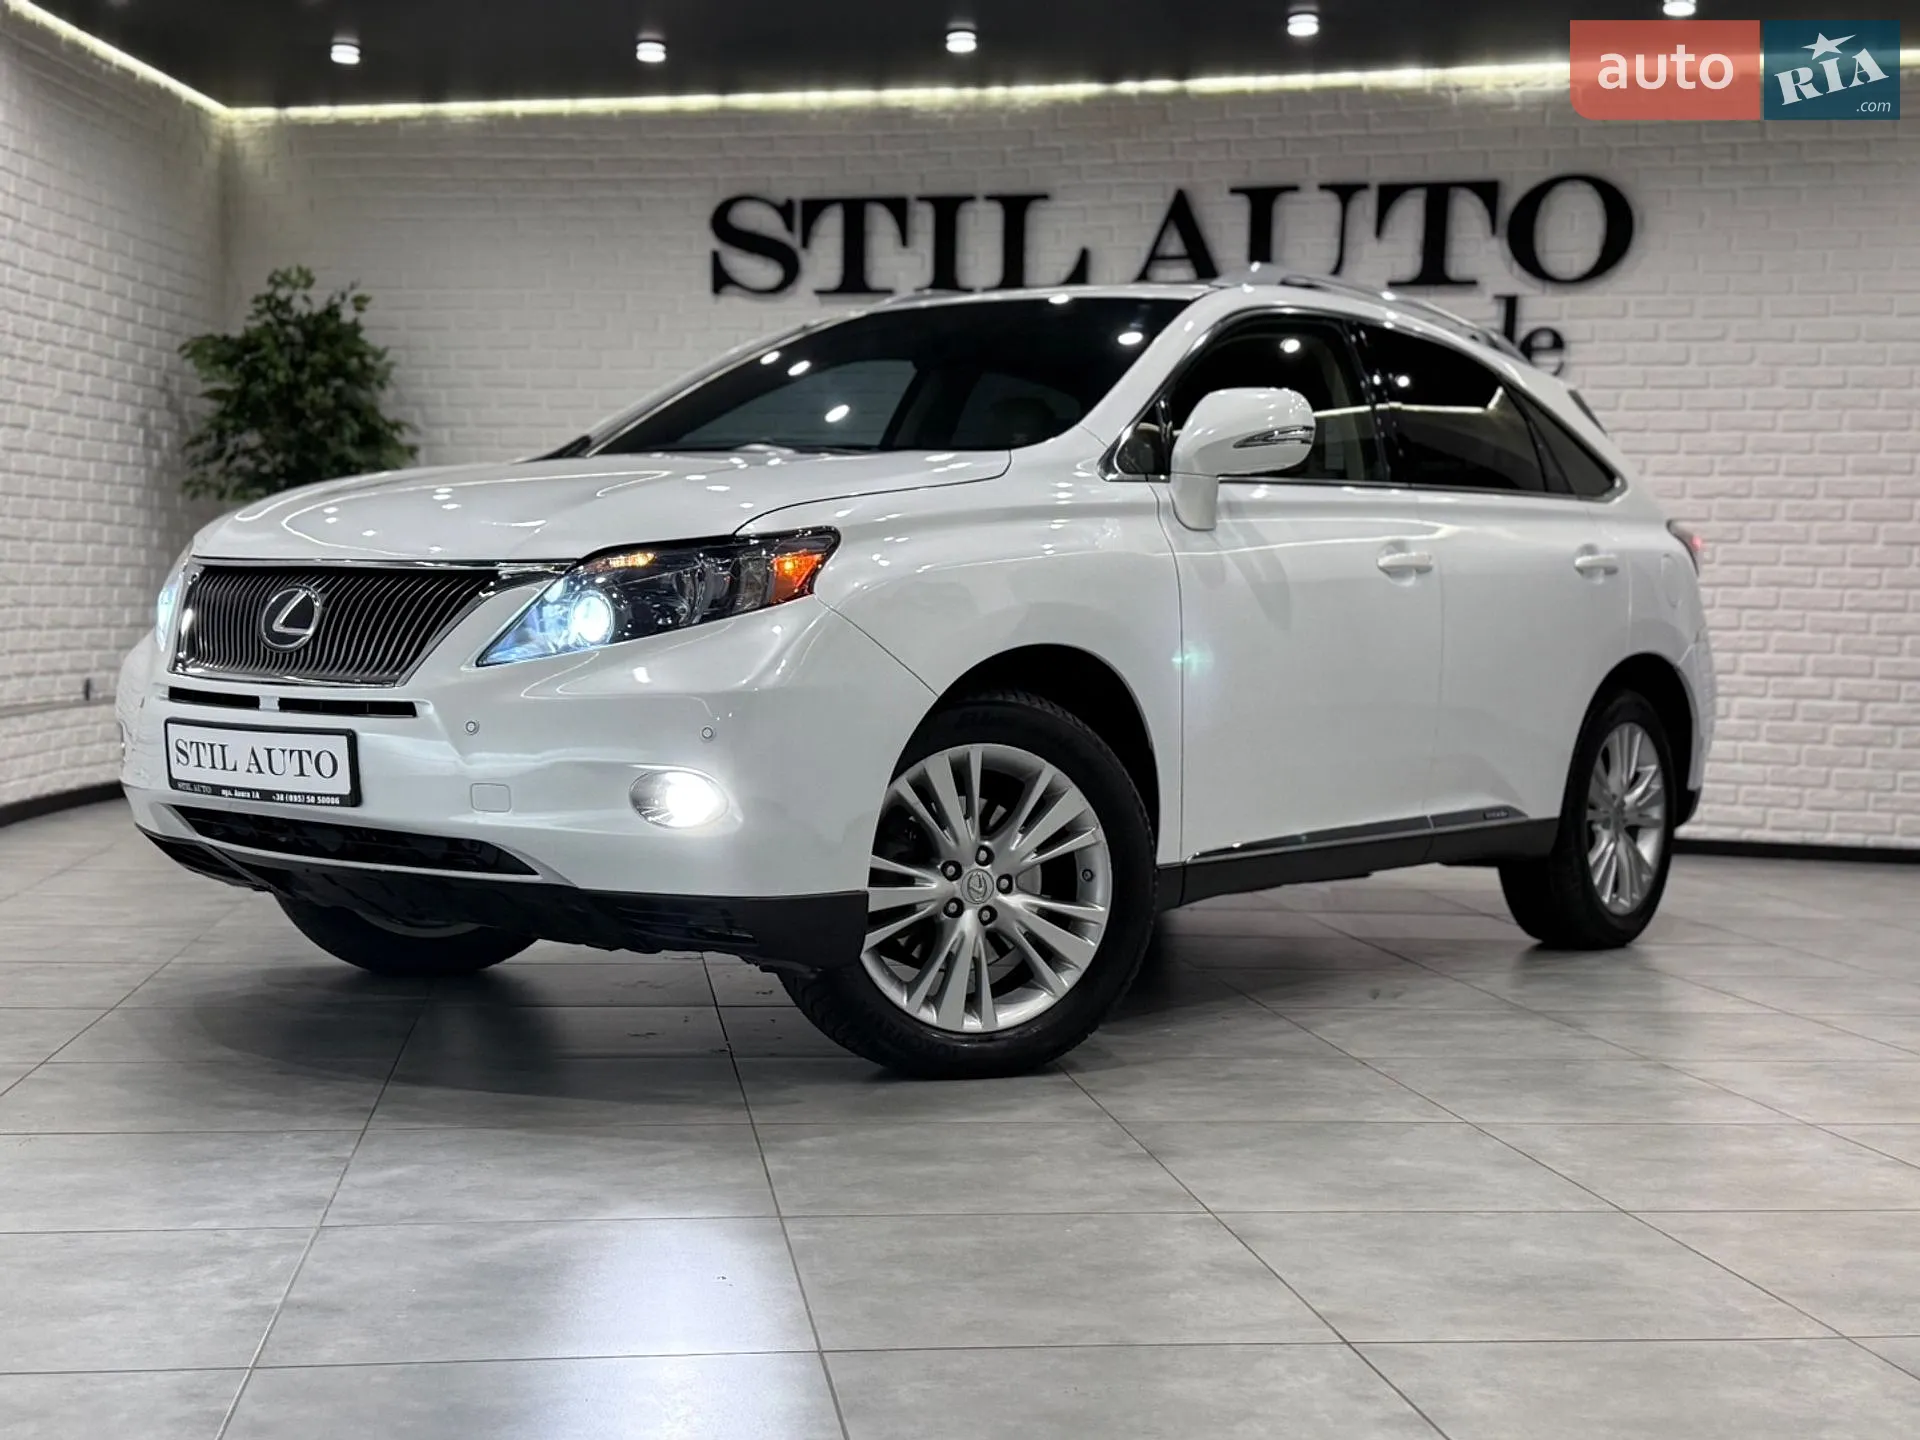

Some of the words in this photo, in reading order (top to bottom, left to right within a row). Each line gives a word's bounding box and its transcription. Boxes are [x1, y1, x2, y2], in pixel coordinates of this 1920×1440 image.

[710, 194, 1090, 295] STIL
[1132, 173, 1635, 287] AUTO
[174, 738, 238, 772] STIL
[245, 746, 339, 779] AUTO
